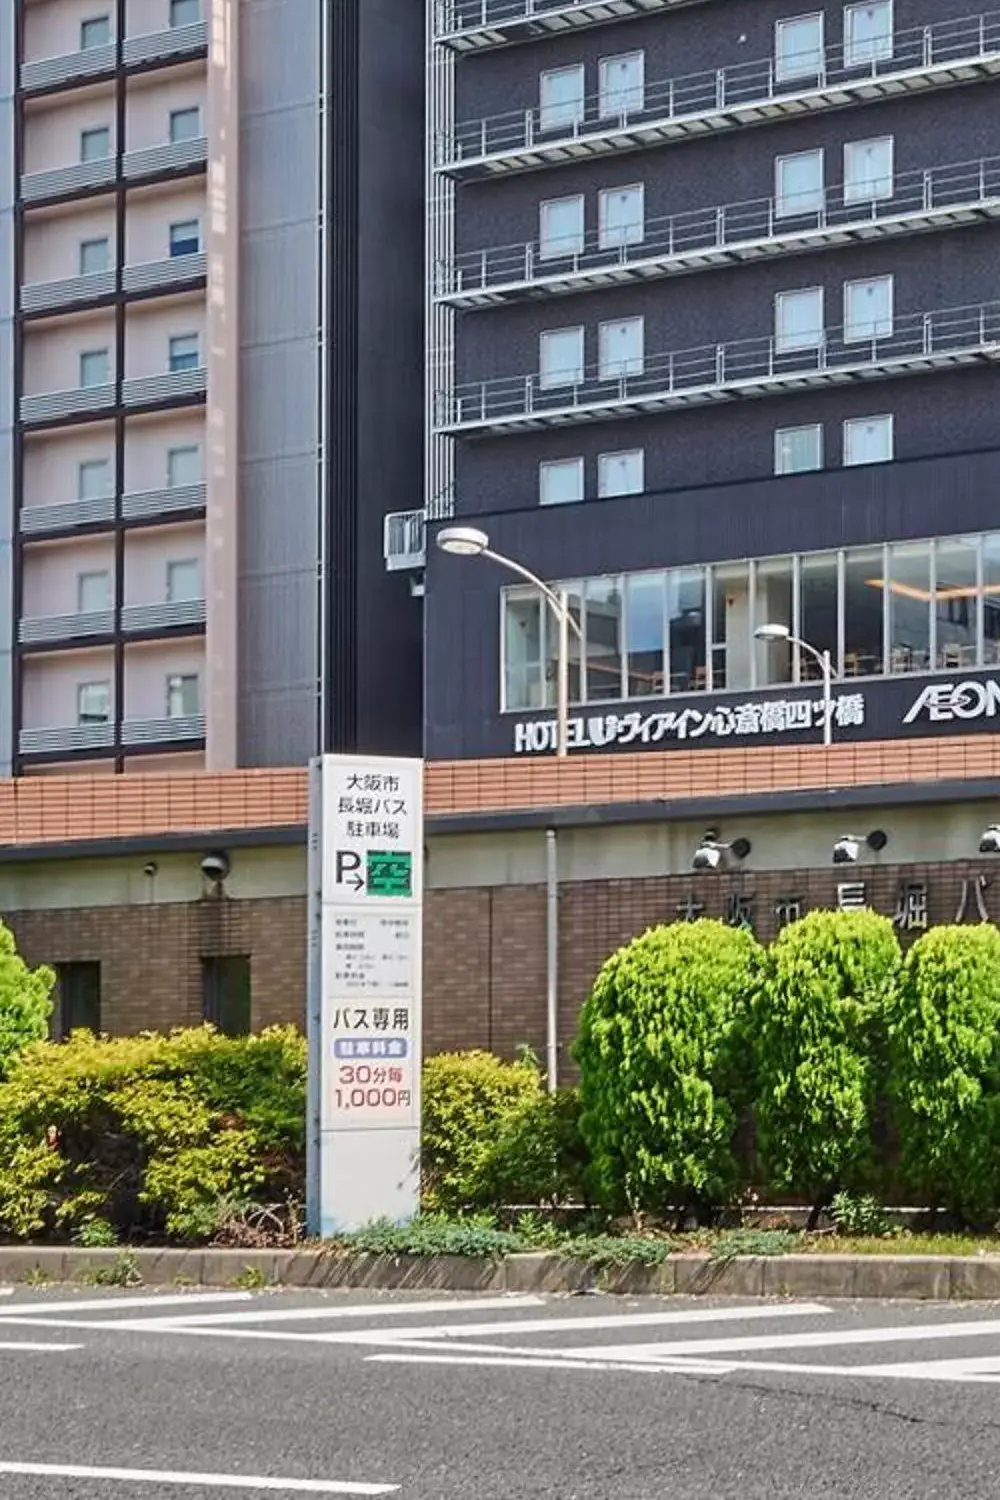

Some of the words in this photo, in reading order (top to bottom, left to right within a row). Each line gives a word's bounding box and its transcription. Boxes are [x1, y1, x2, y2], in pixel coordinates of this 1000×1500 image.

[514, 717, 590, 752] HOTEL
[346, 772, 400, 792] 大阪市
[346, 821, 400, 839] 駐車場
[336, 852, 361, 884] P
[333, 1008, 409, 1031] バス専用
[339, 1065, 403, 1084] 30分毎
[335, 1088, 411, 1110] 1,000円
